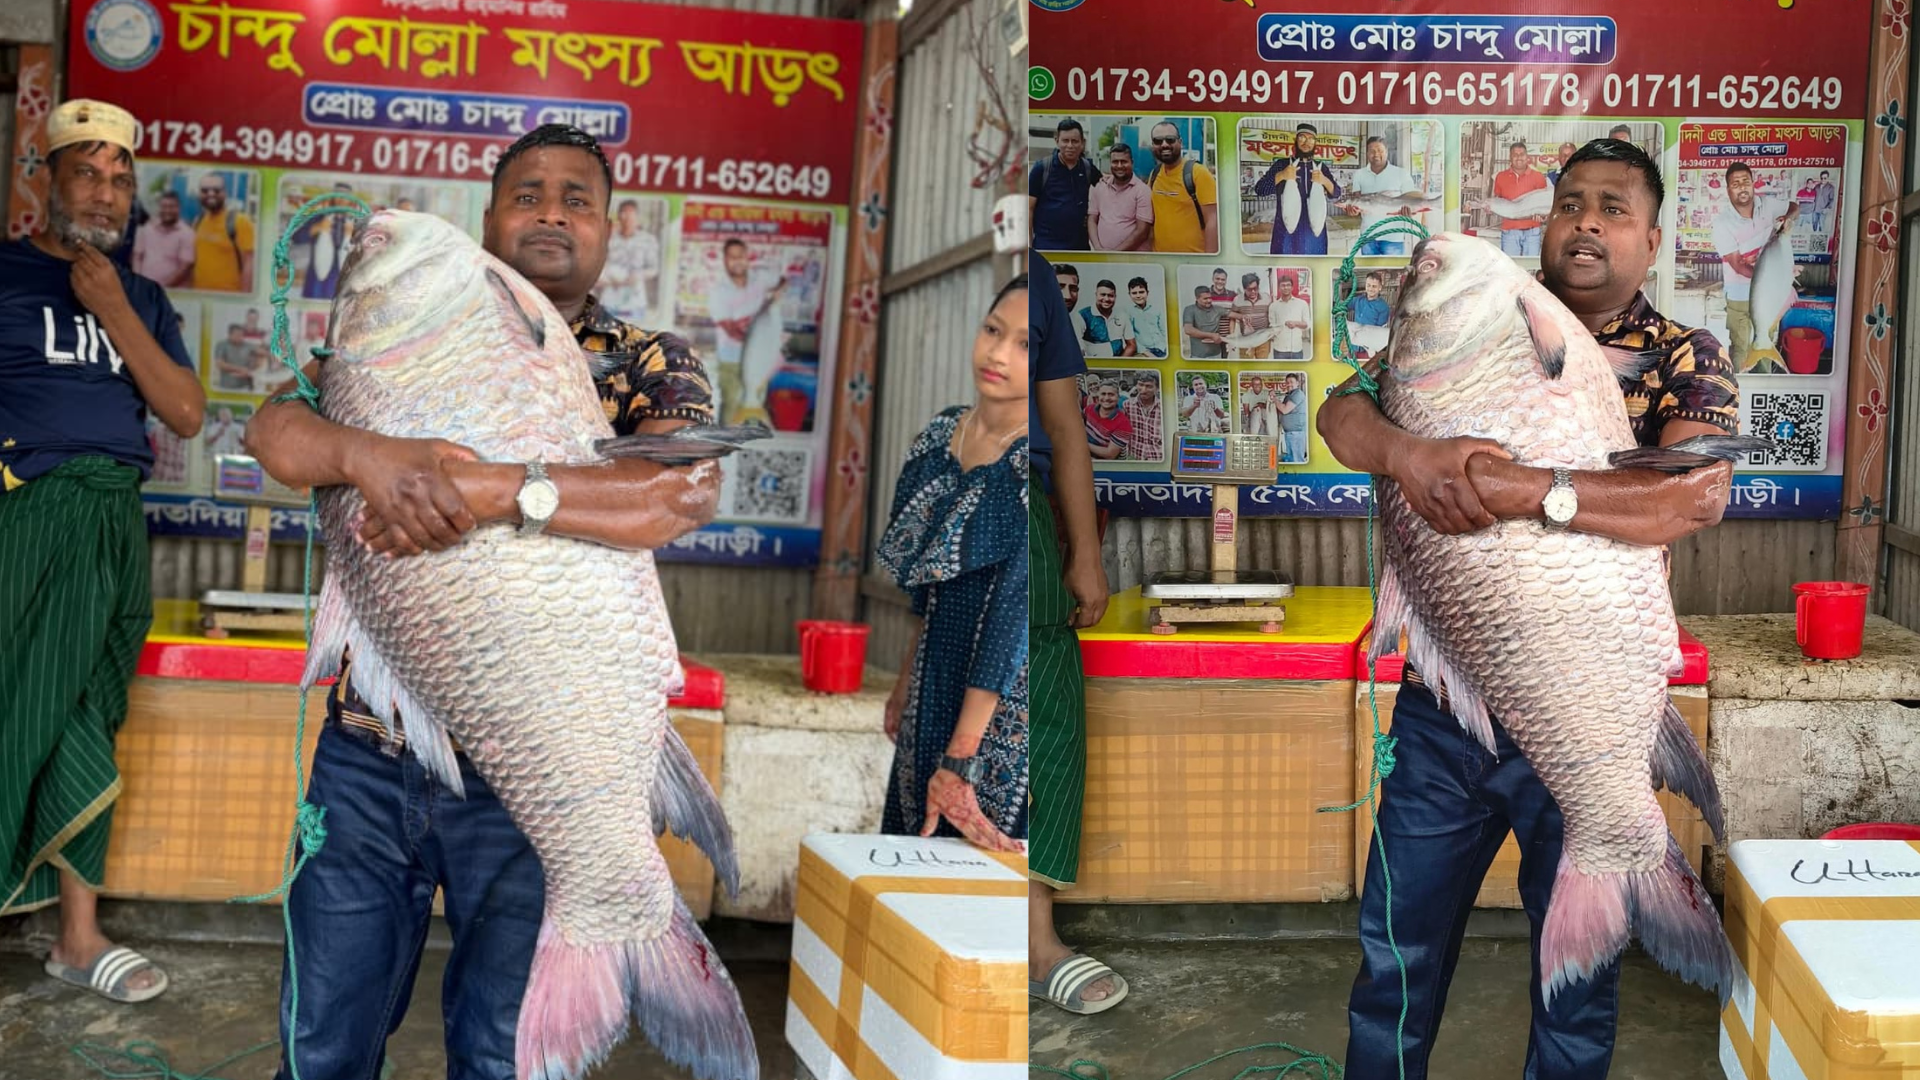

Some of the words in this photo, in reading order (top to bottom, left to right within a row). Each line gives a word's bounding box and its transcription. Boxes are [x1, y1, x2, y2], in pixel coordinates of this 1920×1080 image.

[322, 15, 489, 78] মোল্লা
[503, 28, 664, 87] মৎস্য
[677, 41, 844, 107] আড়ৎ
[1265, 20, 1336, 52] প্রোঃ
[1349, 21, 1417, 52] মোঃ
[1427, 21, 1504, 59] চান্দু
[1514, 22, 1608, 55] মোল্লা
[309, 90, 375, 119] প্রোঃ
[387, 94, 449, 124] মোঃ
[459, 98, 529, 132] চান্দু
[1067, 67, 1324, 110] 01734-394917,
[1337, 71, 1589, 112] 01716-651178,
[1603, 73, 1842, 110] 01711-652649
[1731, 125, 1771, 142] আরিফা
[1774, 126, 1804, 142] মৎস্য
[613, 152, 831, 197] 01711-652649
